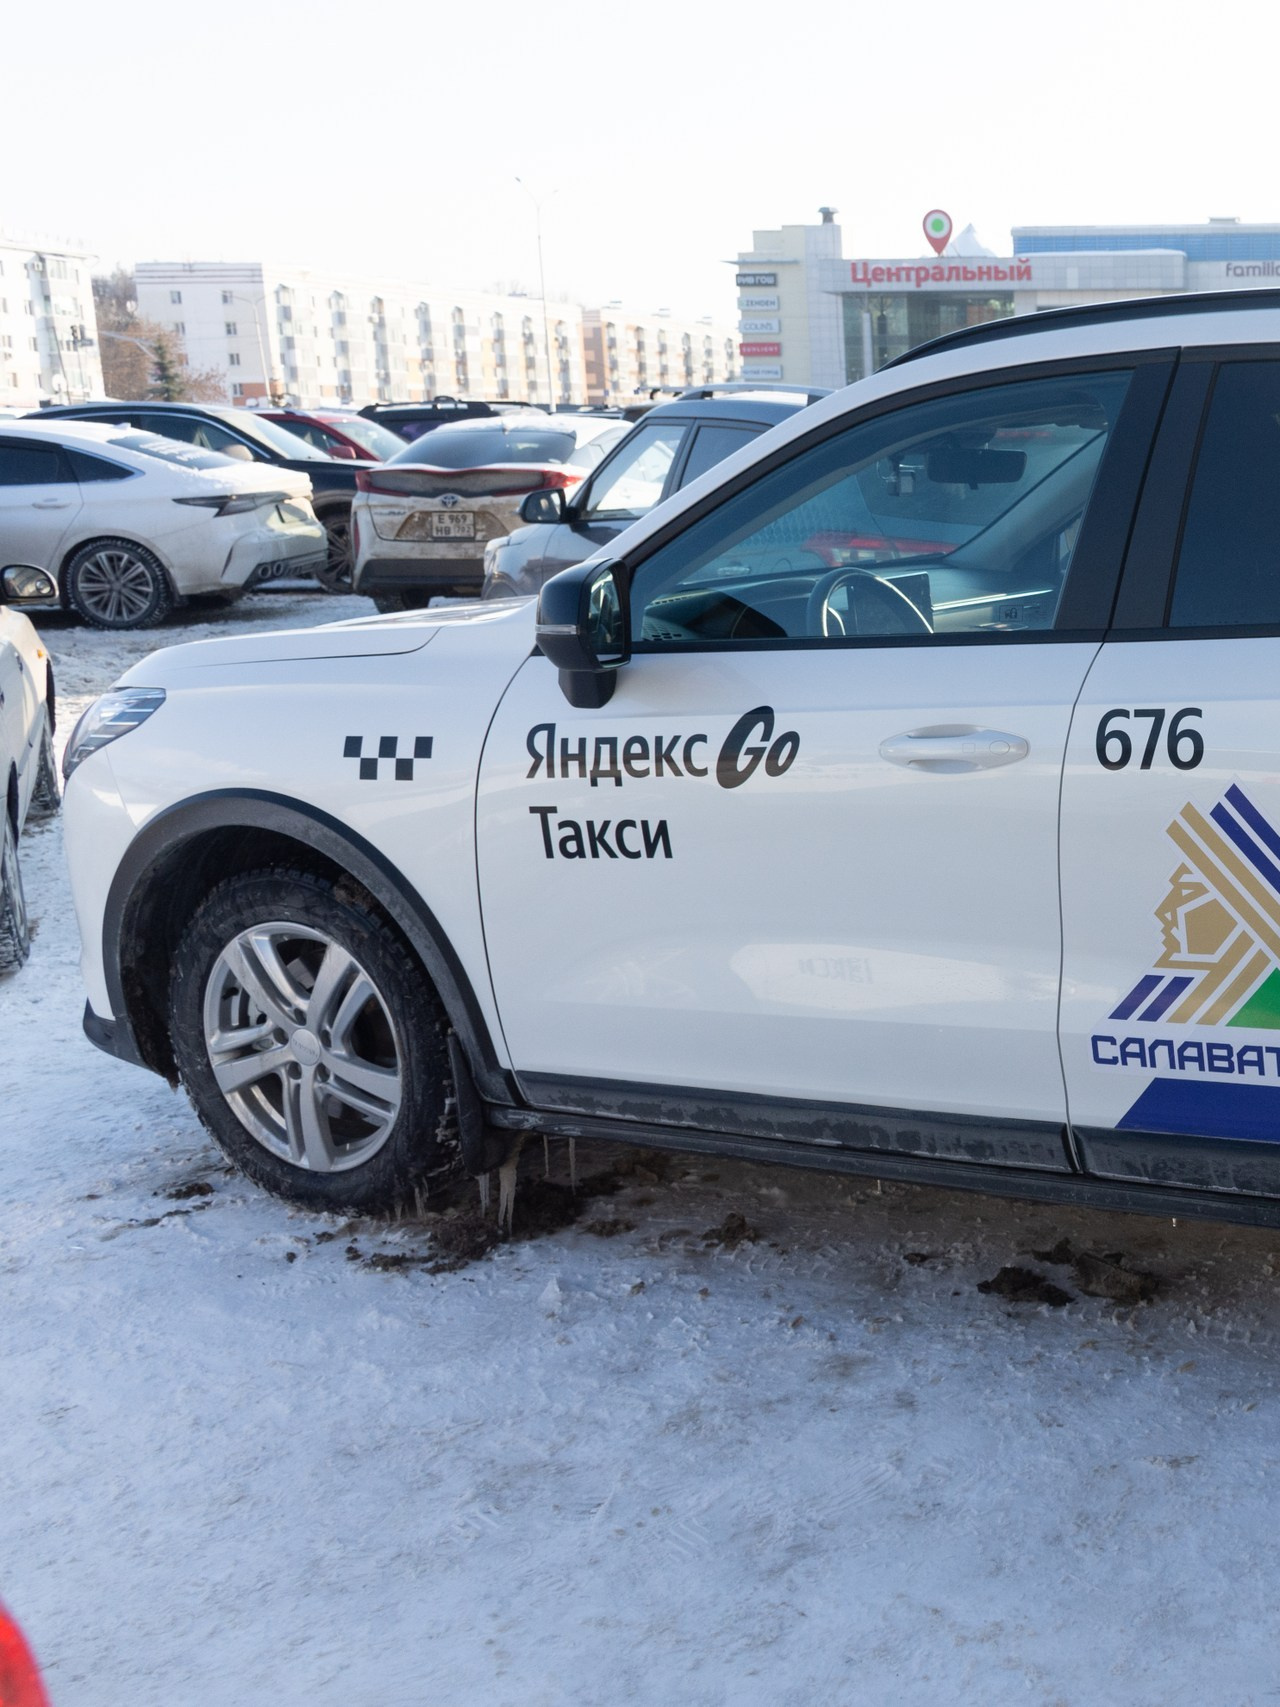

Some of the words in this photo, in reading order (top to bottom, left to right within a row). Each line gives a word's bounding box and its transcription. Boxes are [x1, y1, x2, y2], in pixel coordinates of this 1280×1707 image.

[850, 257, 1032, 288] Центральный
[526, 722, 709, 787] Яндекс
[716, 705, 801, 789] Go
[1095, 707, 1205, 770] 676
[528, 806, 673, 859] Такси
